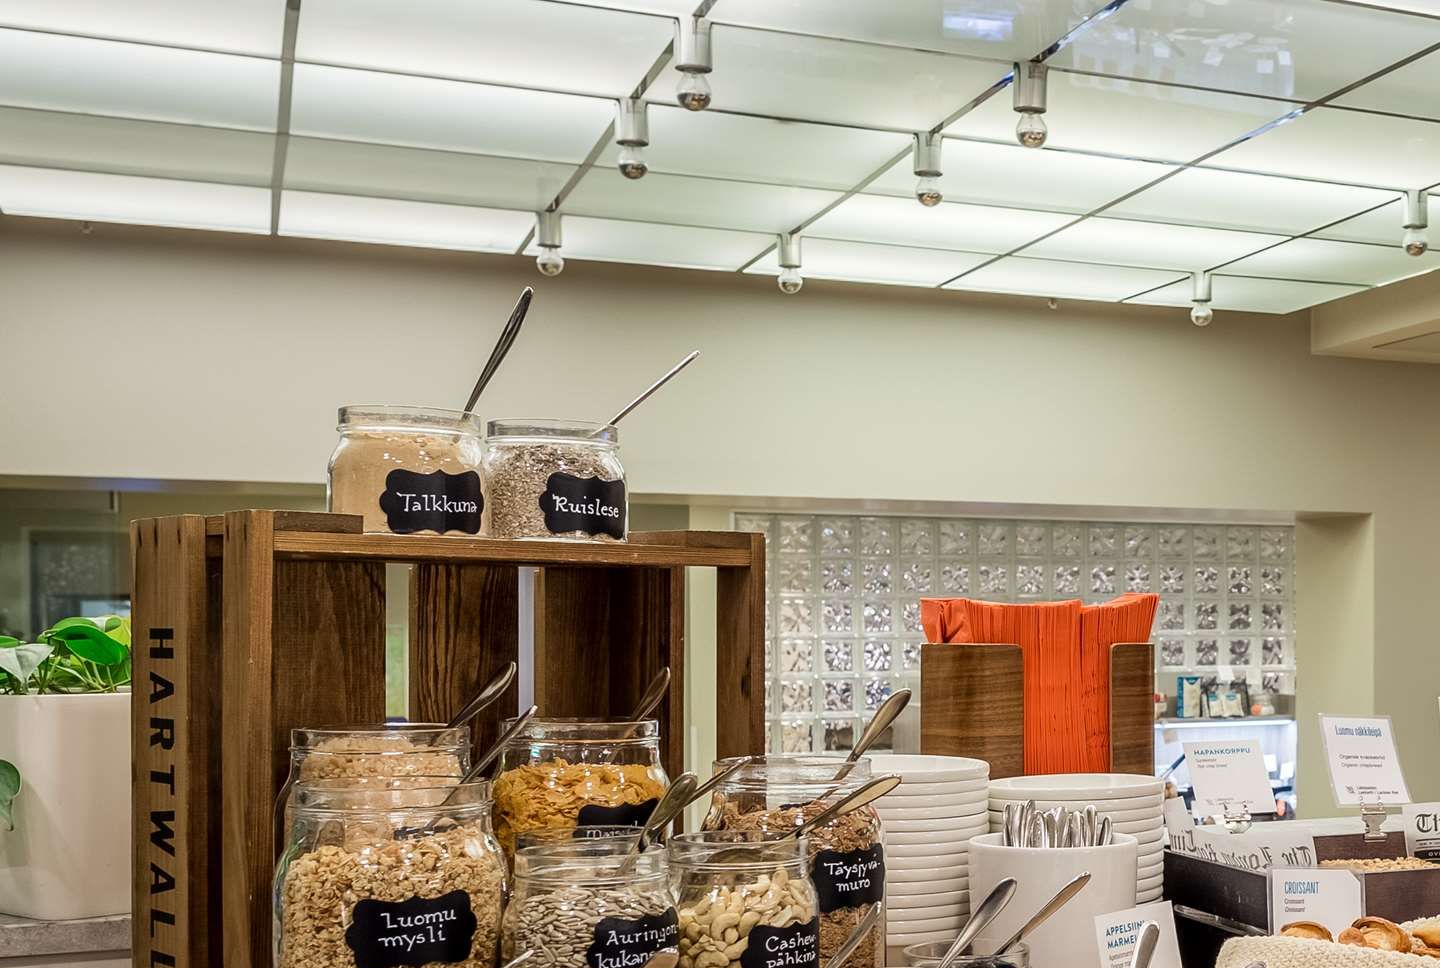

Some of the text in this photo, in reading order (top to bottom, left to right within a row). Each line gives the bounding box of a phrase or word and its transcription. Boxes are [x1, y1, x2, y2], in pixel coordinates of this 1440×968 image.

[396, 491, 478, 513] Talkkuna
[552, 495, 619, 519] Ruislese
[836, 878, 871, 892] muro
[1284, 881, 1319, 895] CROISSANT
[380, 909, 457, 929] Luomu
[378, 924, 446, 951] mysli
